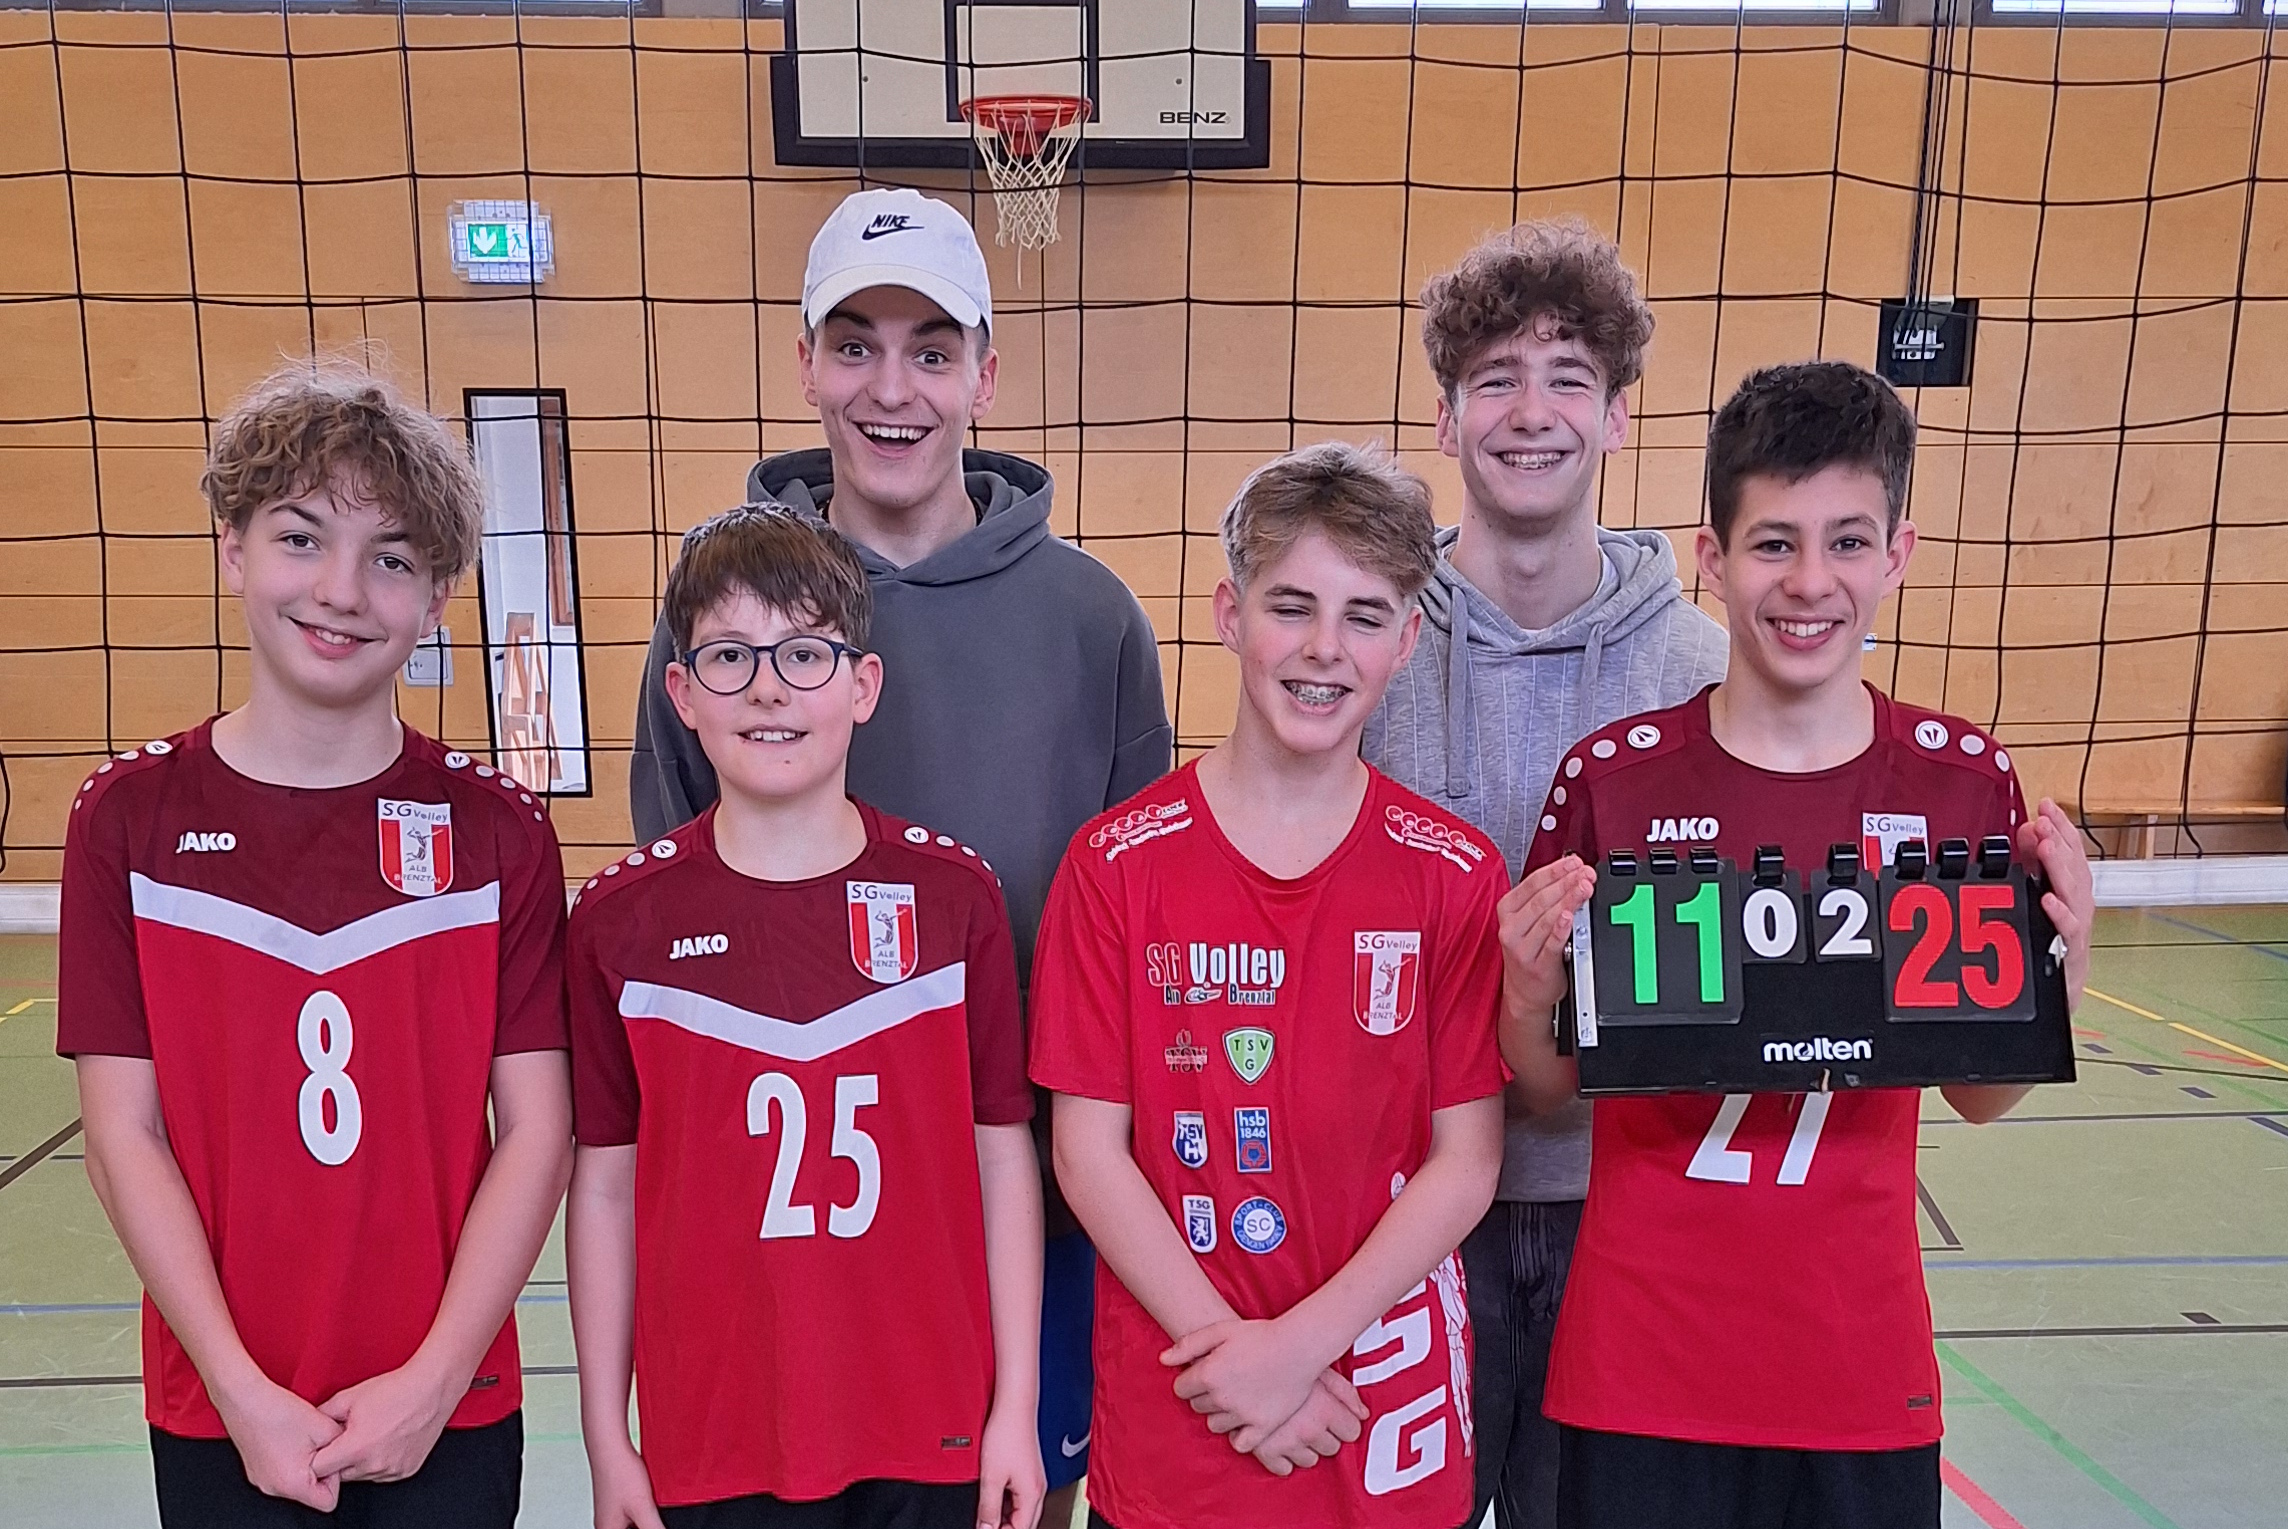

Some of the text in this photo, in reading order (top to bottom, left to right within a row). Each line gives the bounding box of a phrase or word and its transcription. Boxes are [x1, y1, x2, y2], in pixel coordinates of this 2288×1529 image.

[1159, 111, 1227, 124] BENZ
[871, 214, 911, 229] NIKE
[1645, 816, 1720, 843] JAKO
[175, 831, 237, 854] JAKO
[408, 864, 427, 872] ALB
[669, 933, 729, 960] JAKO
[1610, 881, 2025, 1010] 11 0 2 25
[1146, 941, 1286, 989] SG Volley
[1762, 1036, 1873, 1062] molten
[1244, 1058, 1255, 1071] G
[297, 989, 363, 1167] 8
[1238, 1110, 1266, 1127] hsb
[1240, 1127, 1266, 1139] 1846
[746, 1071, 882, 1240] 25
[1187, 1198, 1211, 1210] TSG
[1246, 1216, 1271, 1233] SC
